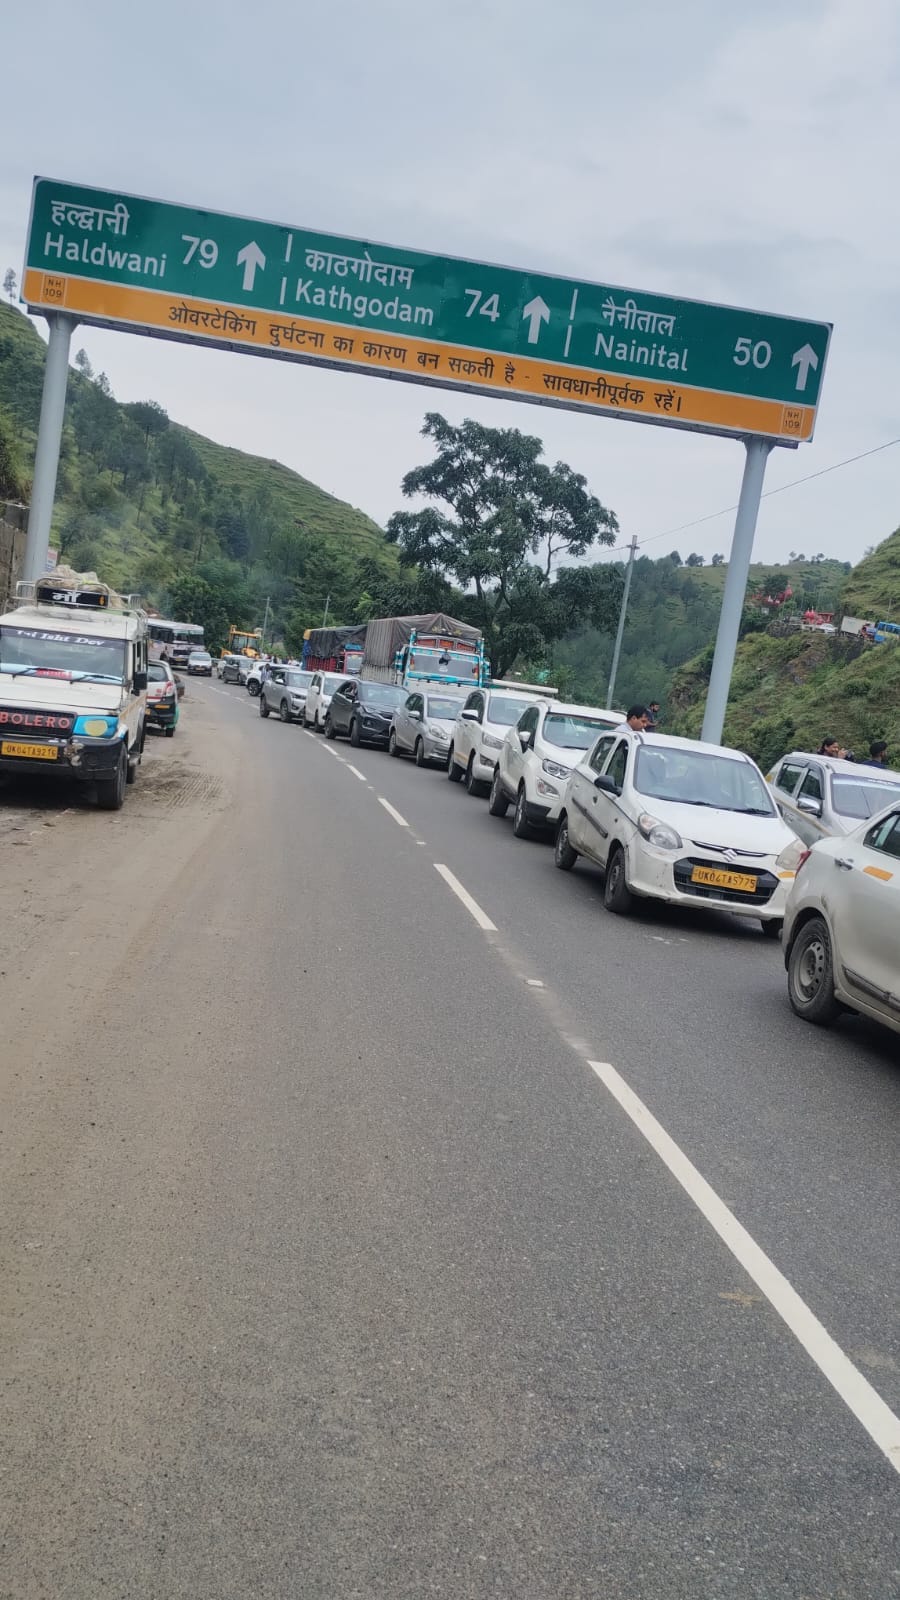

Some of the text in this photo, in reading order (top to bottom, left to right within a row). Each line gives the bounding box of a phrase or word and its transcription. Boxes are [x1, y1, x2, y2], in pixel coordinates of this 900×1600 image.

[50, 200, 130, 236] हल्द्वानी
[43, 231, 168, 277] Haldwani
[180, 234, 219, 269] 79
[304, 248, 415, 290] काठगोदाम
[44, 287, 63, 298] 109
[48, 279, 62, 288] NH
[295, 278, 434, 326] Kathgodam
[464, 288, 501, 322] 74
[601, 296, 677, 337] नैनीताल
[168, 302, 258, 336] ओवरटेकिंग
[269, 321, 325, 348] दुर्घटना
[333, 335, 354, 354] का
[362, 341, 408, 364] कारण
[416, 351, 441, 370] बन
[448, 356, 496, 380] सकती
[504, 361, 516, 384] है
[543, 373, 646, 406] सावधानीपूर्वक
[594, 332, 689, 373] Nainital
[732, 337, 773, 369] 50
[784, 419, 801, 430] 109
[787, 410, 800, 419] NH
[0, 711, 71, 730] BOLERO
